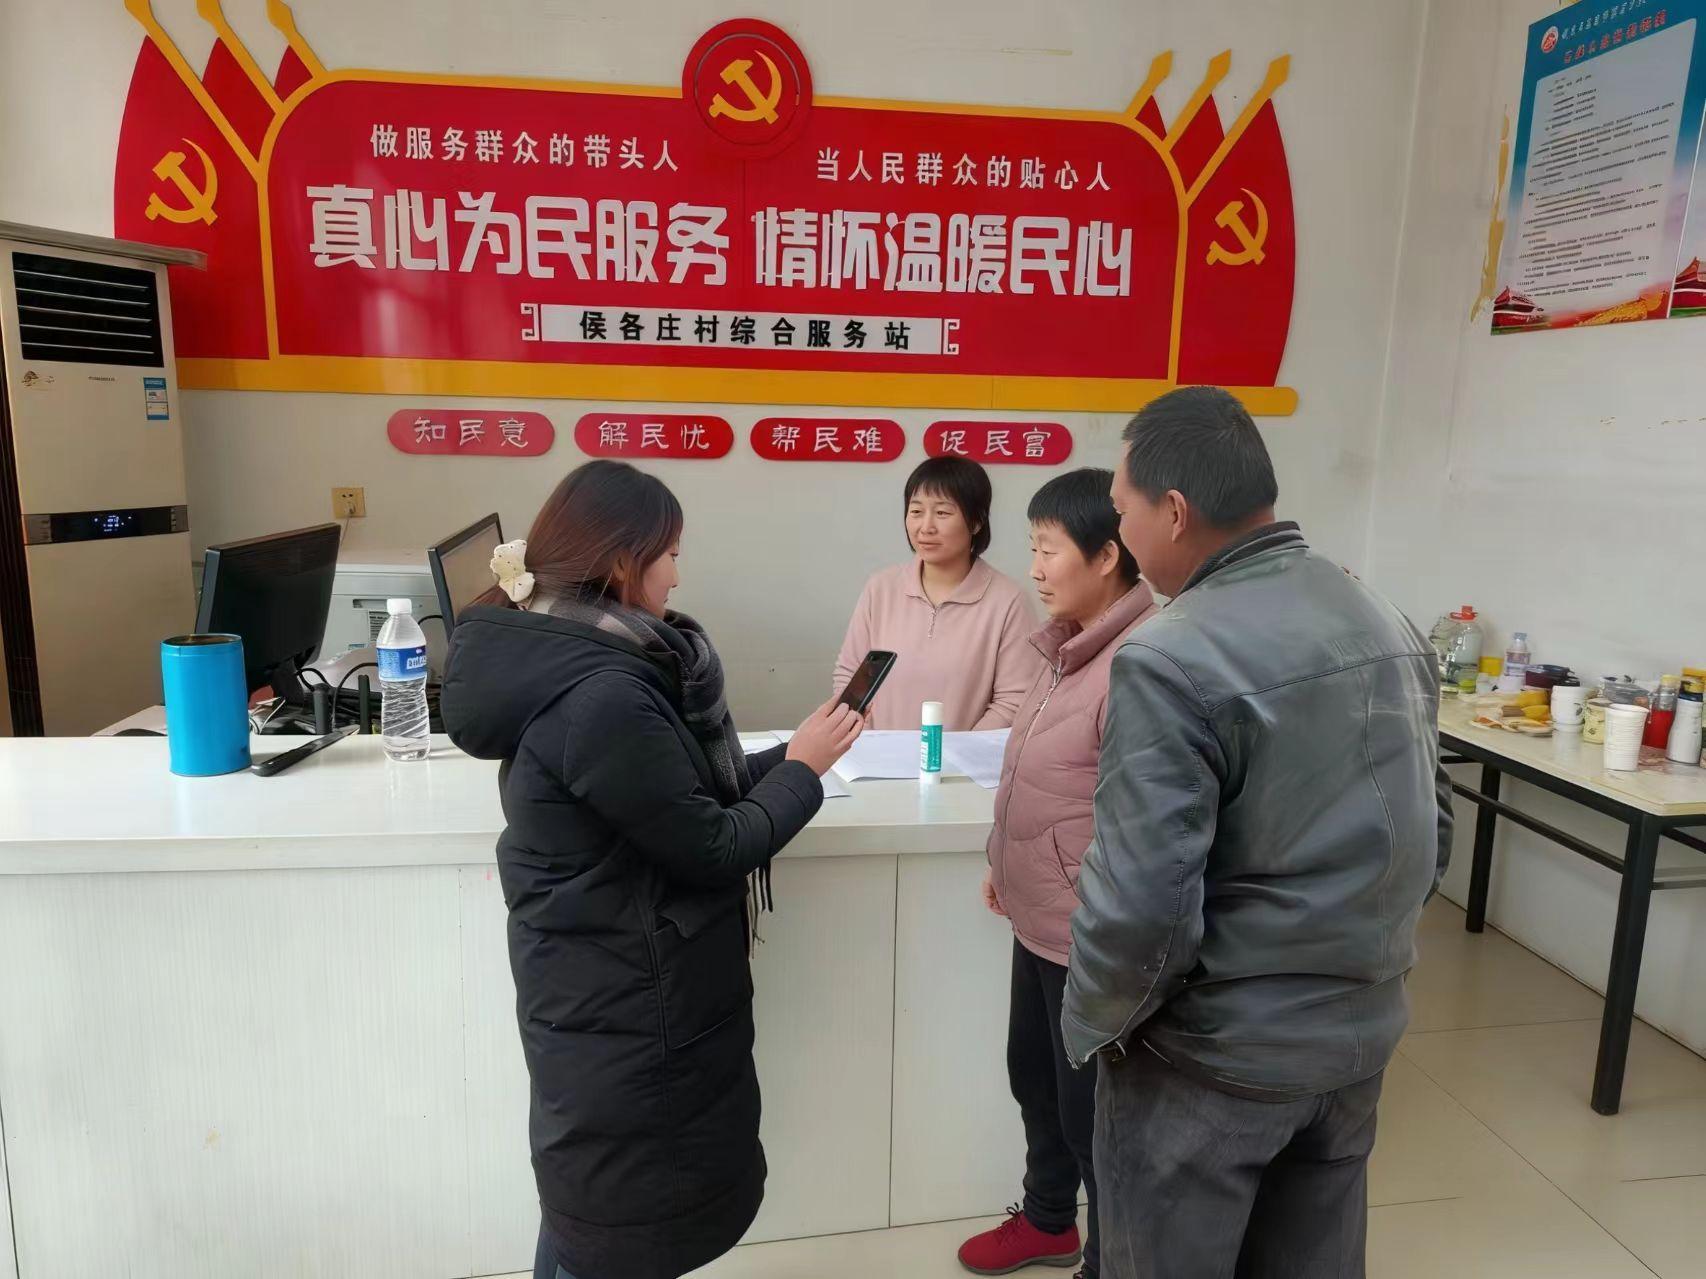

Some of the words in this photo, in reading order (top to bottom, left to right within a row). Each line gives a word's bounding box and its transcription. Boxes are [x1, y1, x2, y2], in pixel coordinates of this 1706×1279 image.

[370, 124, 679, 172] 做服务群众的带头人
[816, 147, 1112, 191] 当人民群众的贴心人
[306, 183, 730, 286] 真心为民服务
[750, 206, 1133, 297] 情怀温暖民心
[579, 310, 912, 350] 侯各庄村综合服务站
[413, 416, 528, 448] 知民意
[598, 420, 710, 450] 解民忧
[771, 424, 883, 454] 帮民难
[939, 427, 1051, 457] 促民富
